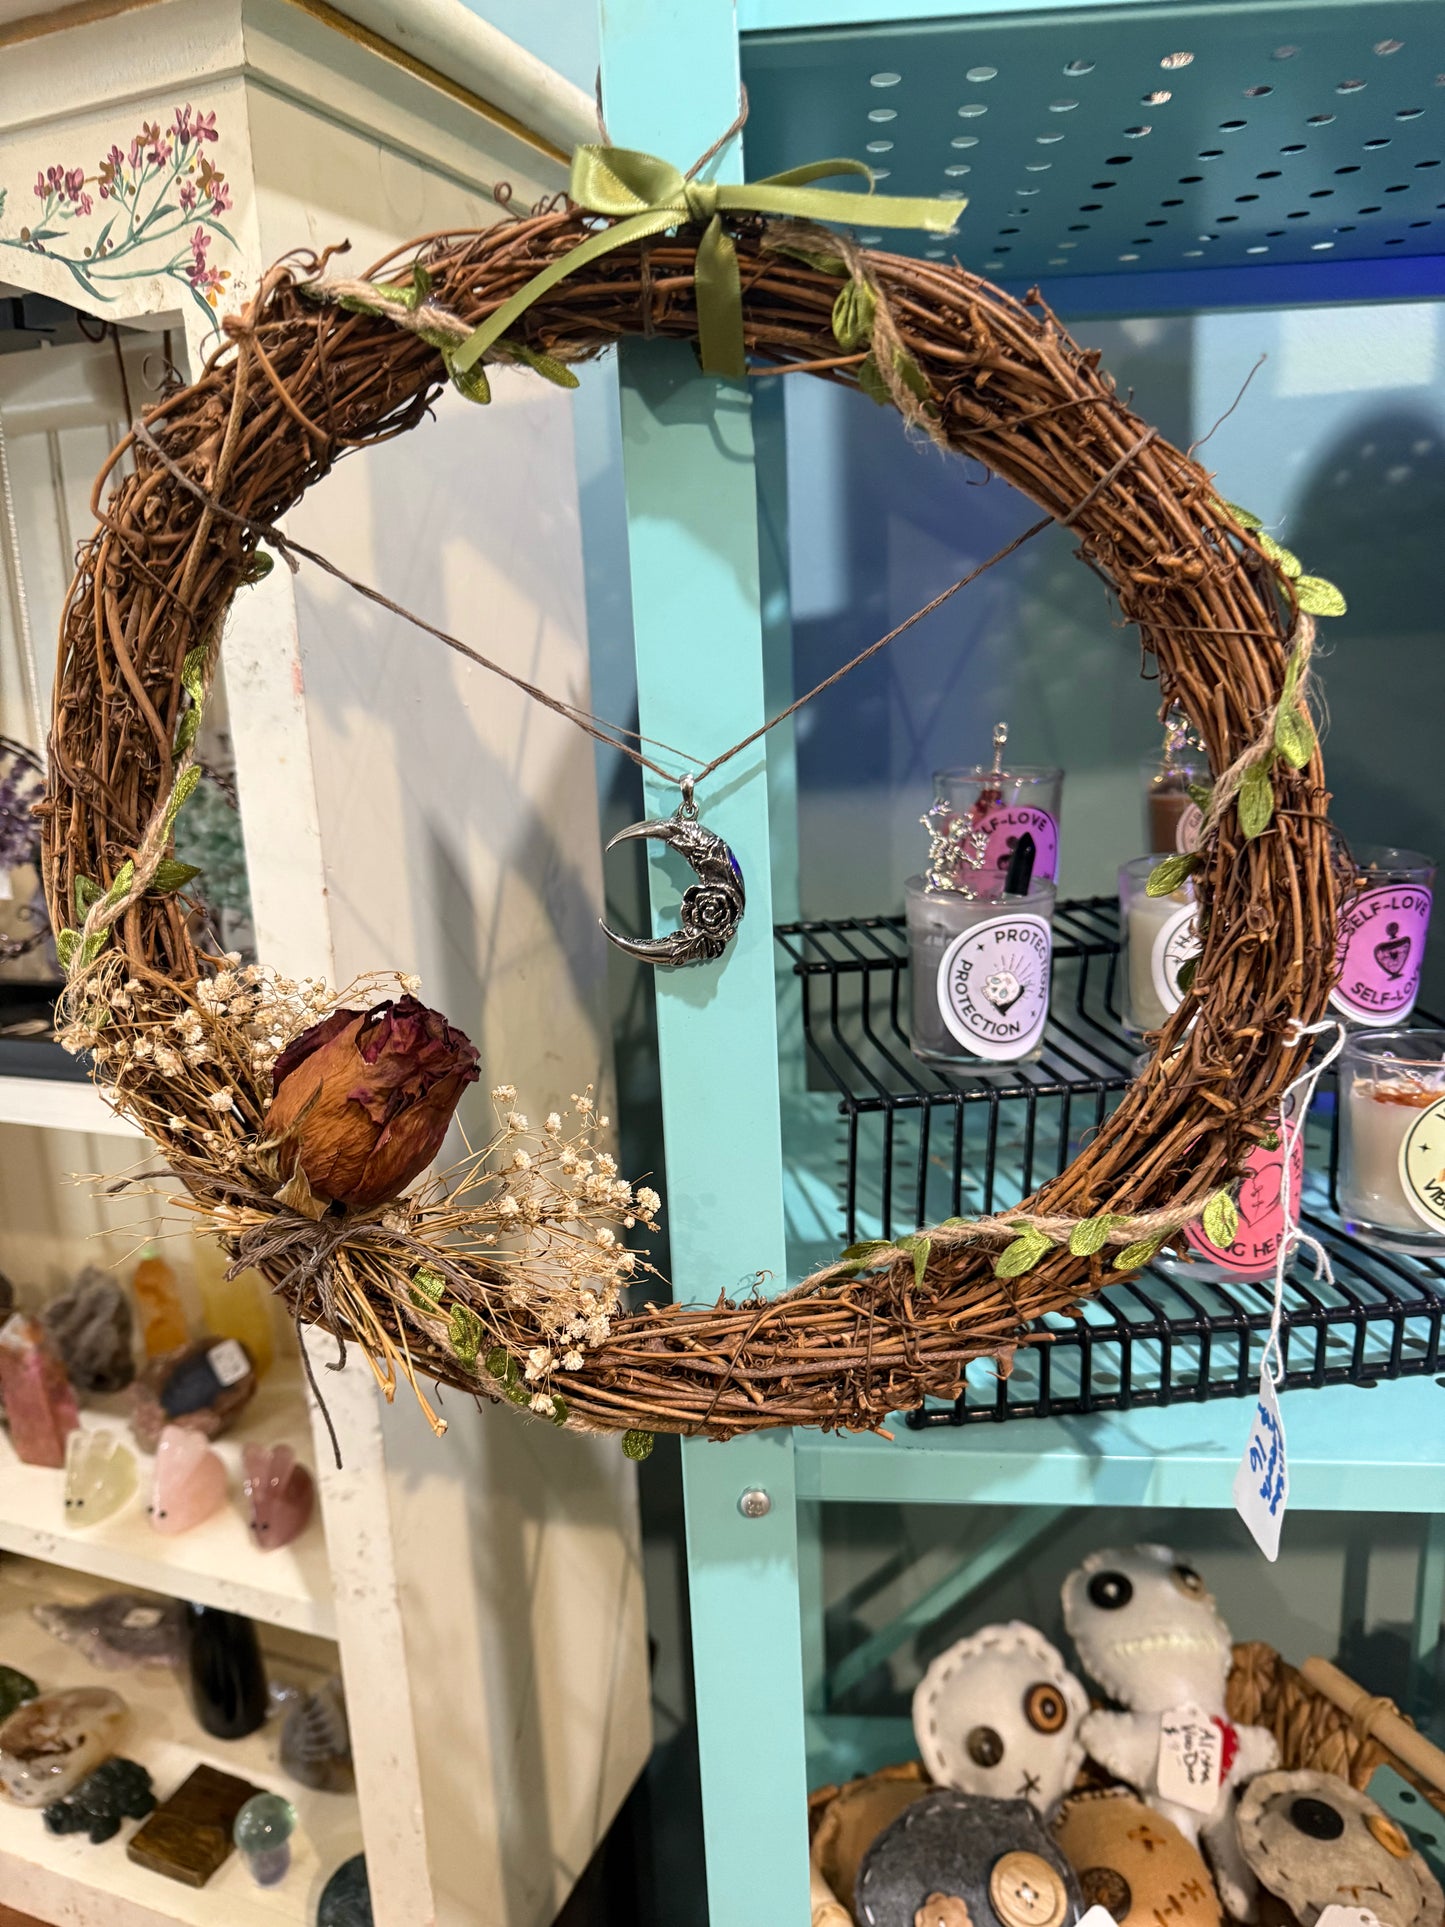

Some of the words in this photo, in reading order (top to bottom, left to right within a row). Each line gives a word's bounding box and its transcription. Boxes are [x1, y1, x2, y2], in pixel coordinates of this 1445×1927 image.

[1338, 895, 1429, 937] SELF-LOVE
[994, 928, 1050, 999] PROTECTION
[954, 958, 1021, 1037] PROTECTION
[1423, 1178, 1445, 1210] VIB
[1249, 1434, 1267, 1472] 16
